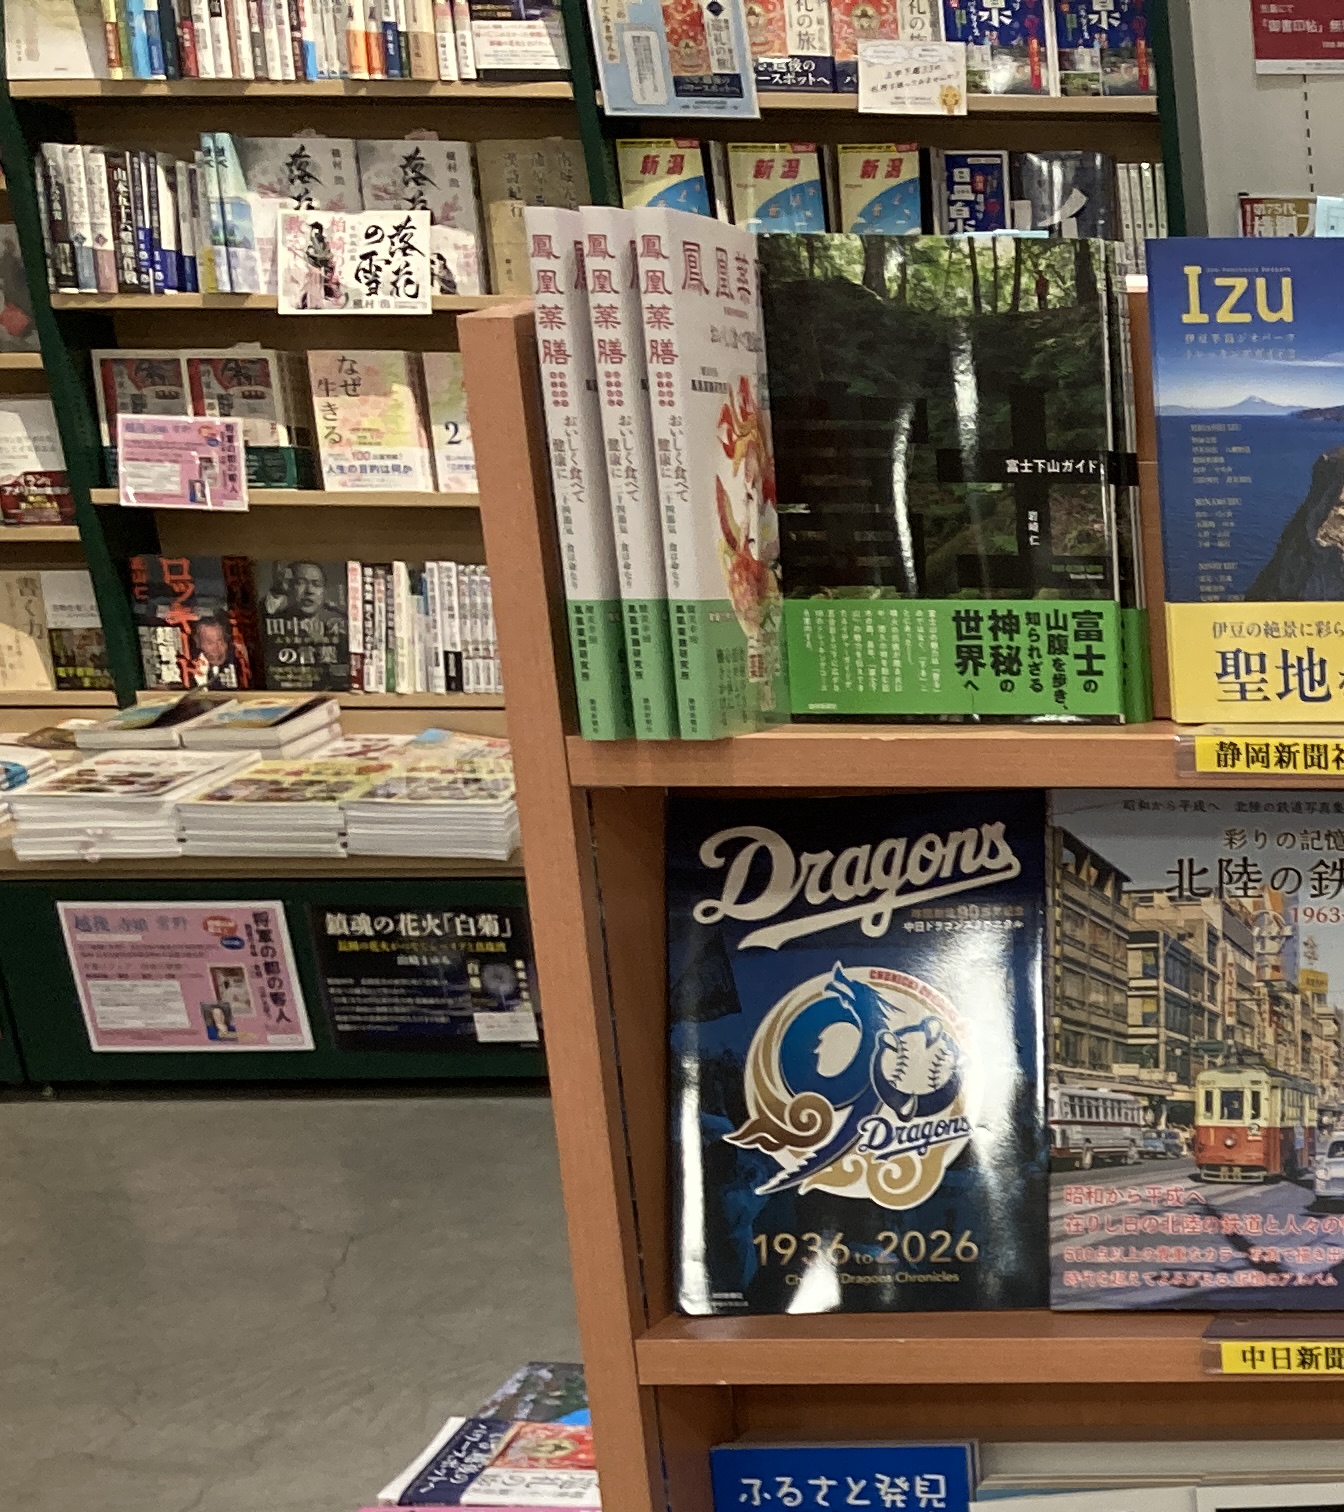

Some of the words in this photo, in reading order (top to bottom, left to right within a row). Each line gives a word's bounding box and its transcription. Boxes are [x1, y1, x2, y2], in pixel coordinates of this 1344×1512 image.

[353, 221, 386, 300] の雪
[387, 216, 425, 300] 落花
[531, 233, 572, 366] 鳳凰薬膳
[587, 233, 628, 366] 鳳凰薬膳
[641, 233, 680, 366] 鳳凰薬膳
[1180, 263, 1296, 325] Izu
[1006, 459, 1098, 475] 富士下山ガイド
[952, 608, 986, 692] 世界へ
[988, 609, 1023, 693] 神秘の
[1024, 611, 1044, 693] 知られざる
[1046, 608, 1071, 711] 山腹を歩き、
[1073, 609, 1106, 694] 富士の
[325, 911, 512, 938] 鎮魂の花火「白菊」
[693, 822, 1021, 951] Dragons
[857, 1115, 971, 1161] Dragons
[739, 1473, 948, 1508] ふるさと発見
